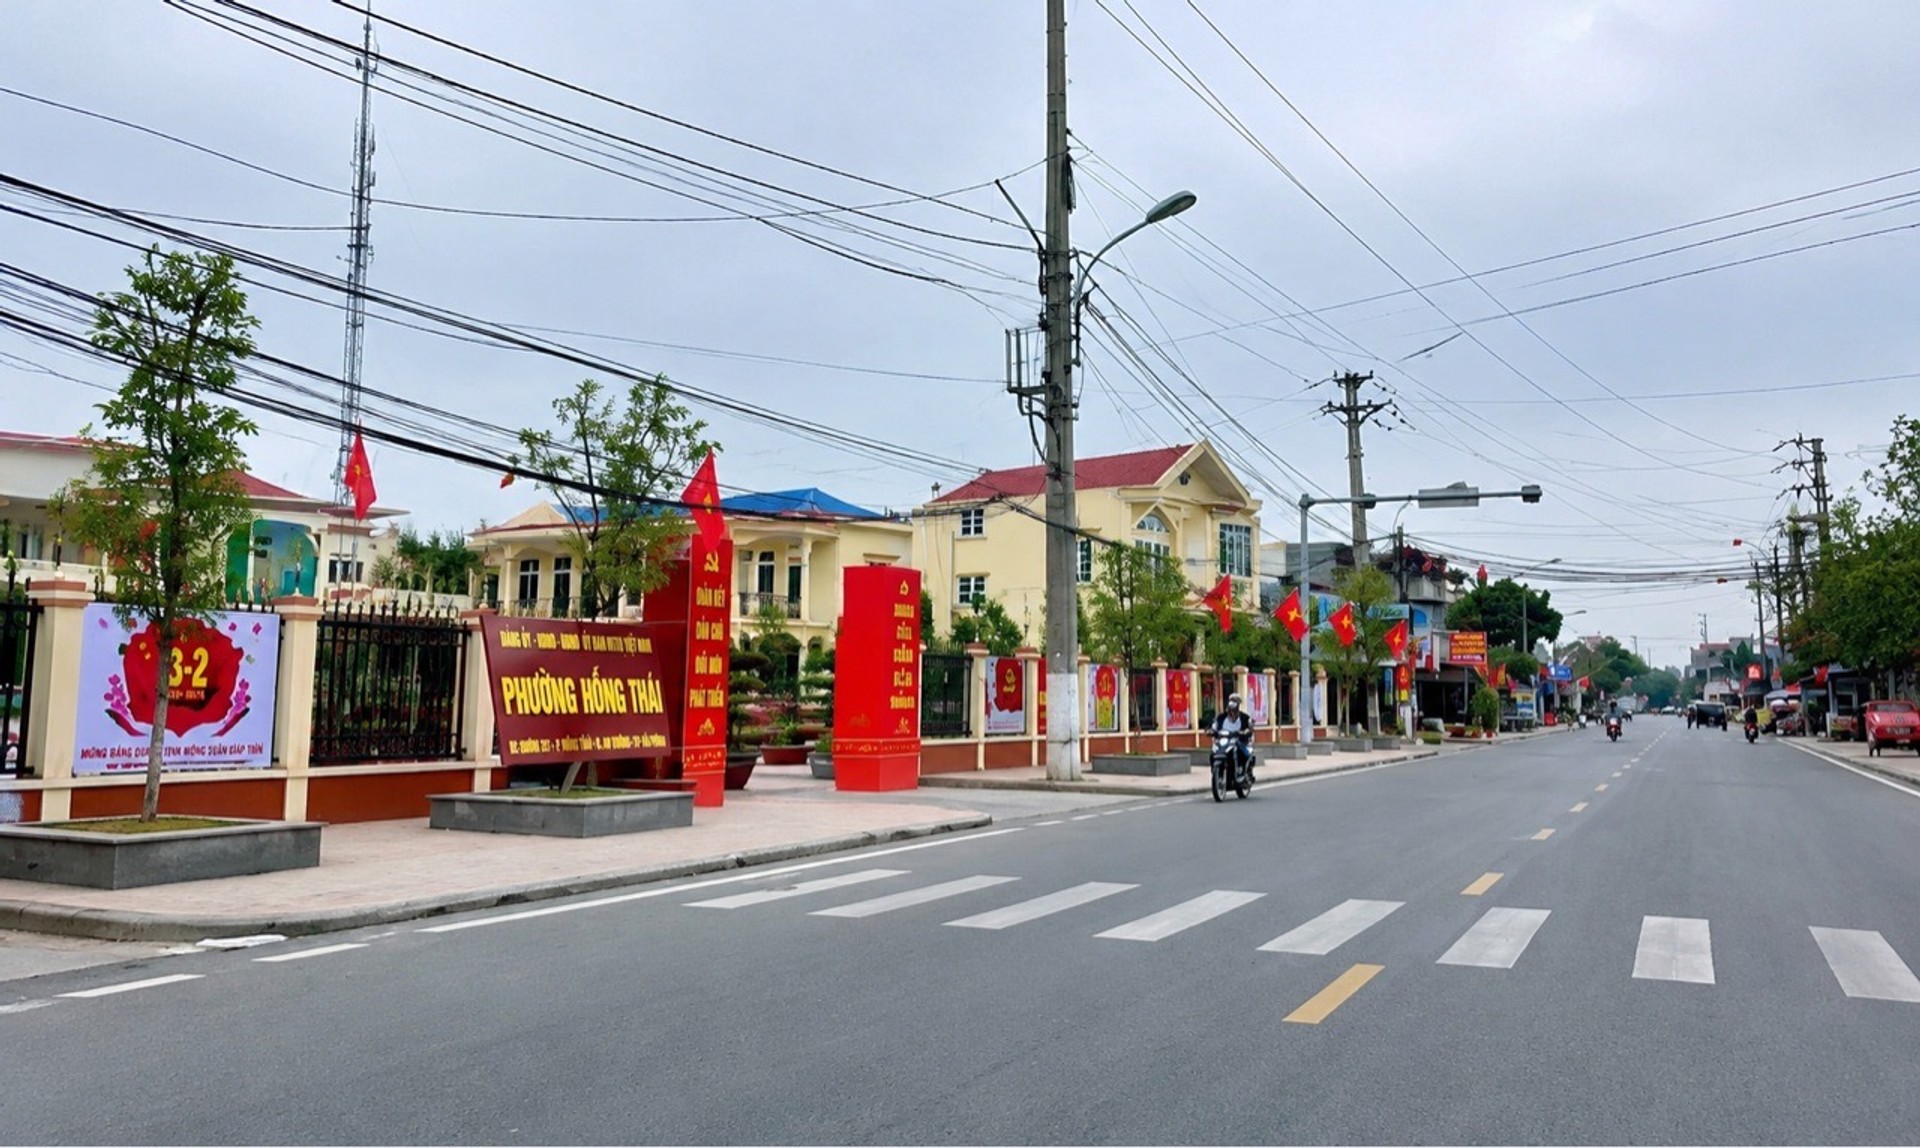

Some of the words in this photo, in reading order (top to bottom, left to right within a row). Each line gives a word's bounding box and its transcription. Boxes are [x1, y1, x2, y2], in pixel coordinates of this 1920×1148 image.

[168, 646, 209, 688] 3-2
[501, 666, 579, 715] PHƯỜNG
[627, 671, 664, 714] THÁI
